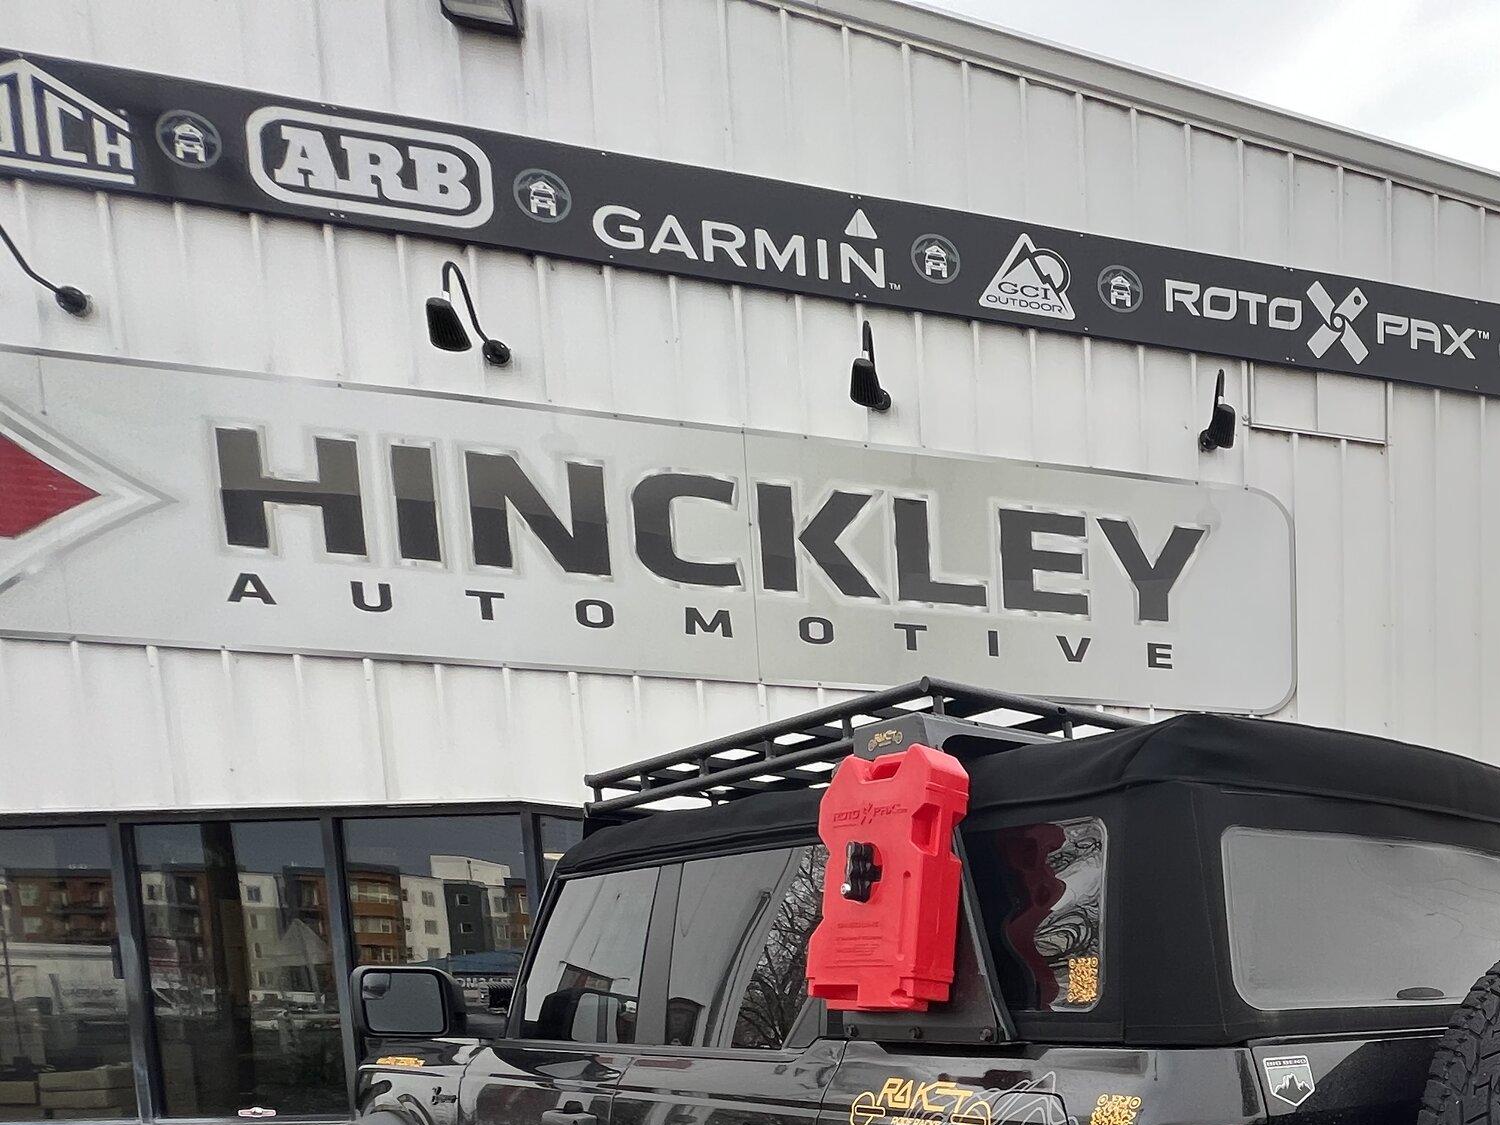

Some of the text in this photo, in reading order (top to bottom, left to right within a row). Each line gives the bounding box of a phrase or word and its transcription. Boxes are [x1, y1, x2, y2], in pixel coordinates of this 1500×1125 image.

[0, 59, 134, 170] TCH
[273, 124, 471, 212] ARB
[592, 204, 886, 289] GARMIN
[985, 294, 1063, 314] OUTDOOR
[998, 281, 1051, 300] GCI
[1165, 279, 1302, 331] ROTO
[1377, 312, 1475, 360] PAX
[212, 424, 1208, 624] HINCKLEY
[227, 572, 1173, 670] AUTOMOTIVE
[876, 1077, 974, 1114] RAKET
